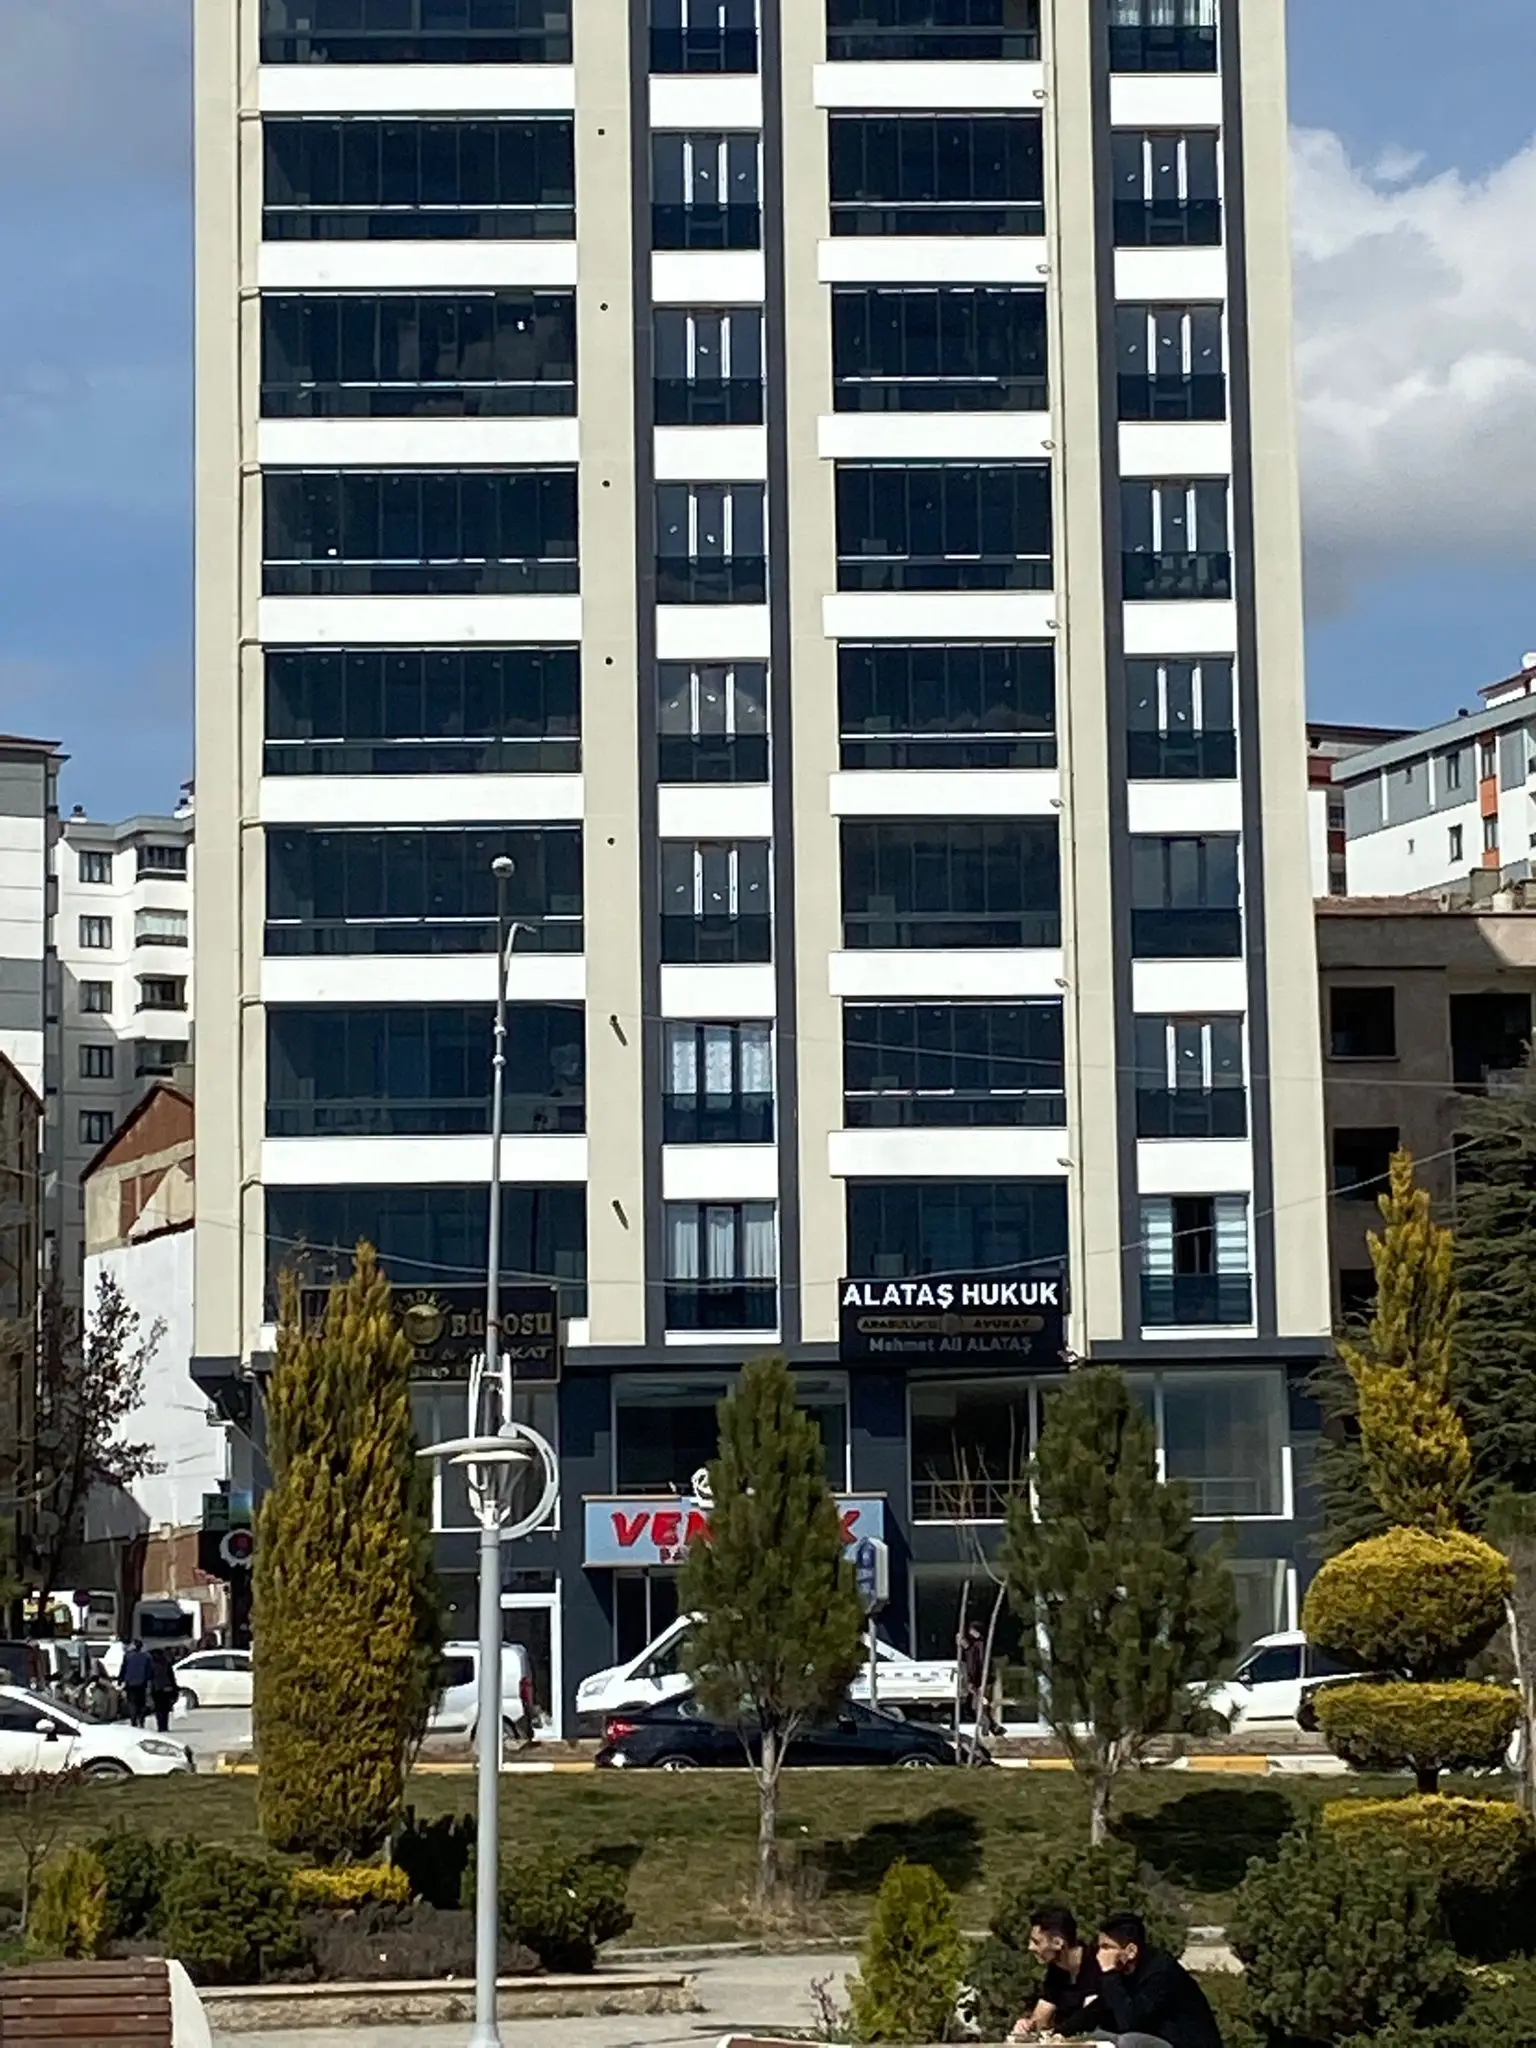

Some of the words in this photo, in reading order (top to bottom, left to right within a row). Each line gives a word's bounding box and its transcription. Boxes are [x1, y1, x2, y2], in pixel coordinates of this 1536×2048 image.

[842, 1283, 954, 1309] ALATAŞ
[962, 1282, 1058, 1306] HUKUK
[450, 1308, 553, 1337] BÜOSU
[869, 1336, 934, 1352] Mehmet
[940, 1336, 962, 1352] Ali
[966, 1336, 1032, 1355] ALATAŞ
